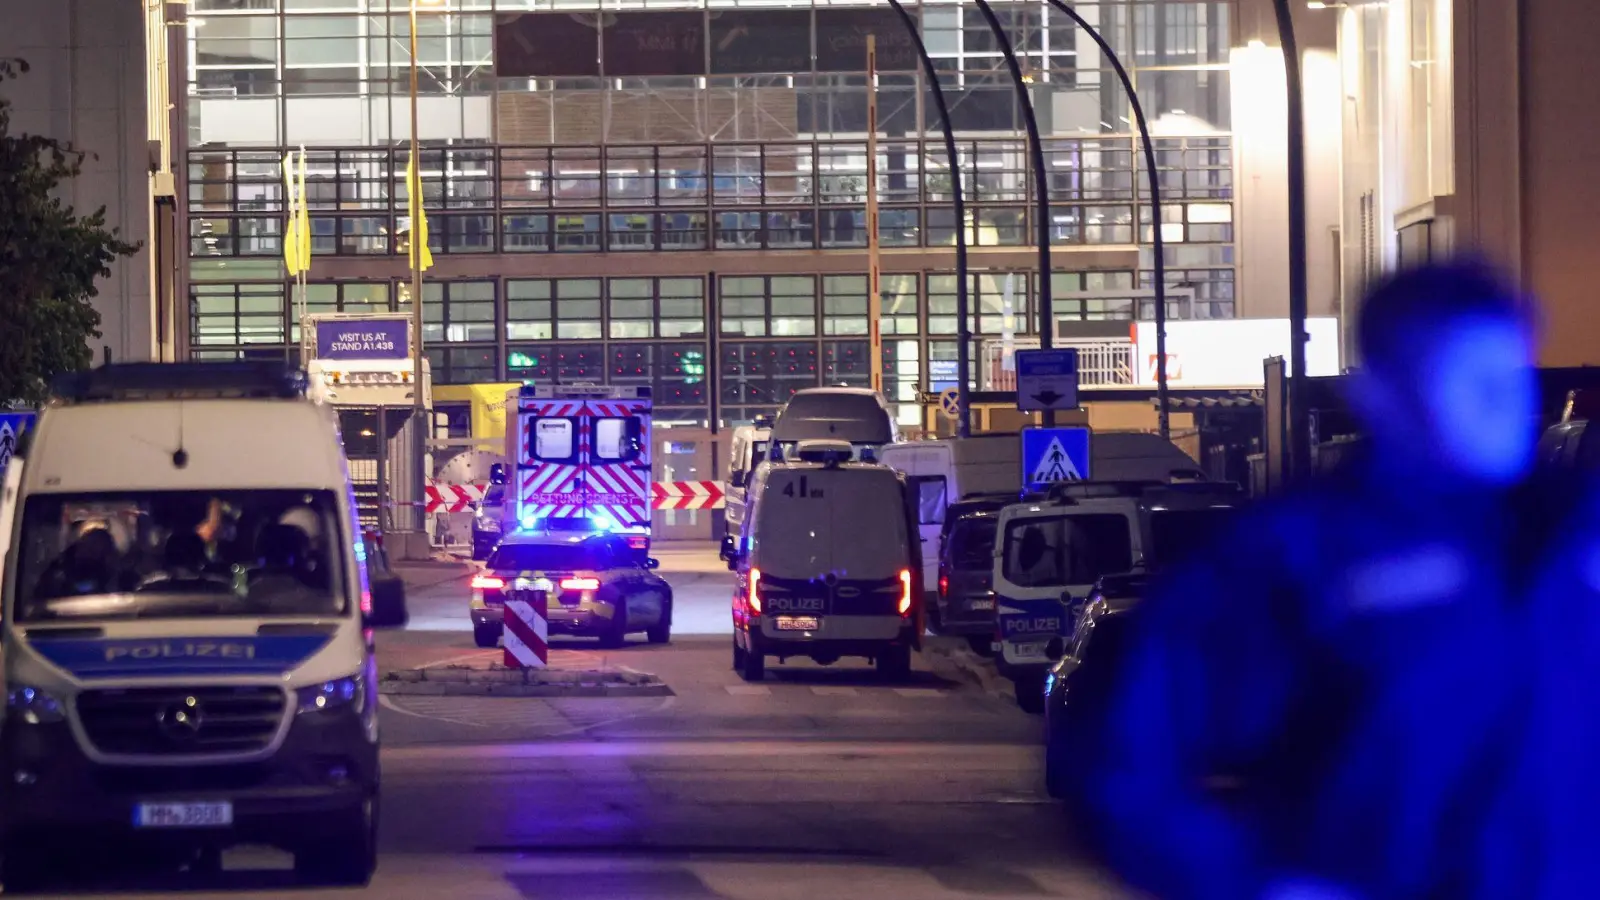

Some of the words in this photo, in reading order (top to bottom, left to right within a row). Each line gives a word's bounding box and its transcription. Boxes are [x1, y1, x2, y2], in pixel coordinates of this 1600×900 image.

[339, 333, 360, 342] VISIT
[361, 333, 374, 342] US
[374, 332, 387, 341] AT
[331, 342, 361, 351] STAND
[363, 341, 394, 351] A1.438
[531, 492, 639, 504] RETTUNGSDIENST
[768, 598, 824, 610] POLIZEI
[1006, 616, 1060, 632] POLIZEI
[105, 642, 255, 664] POLIZEI
